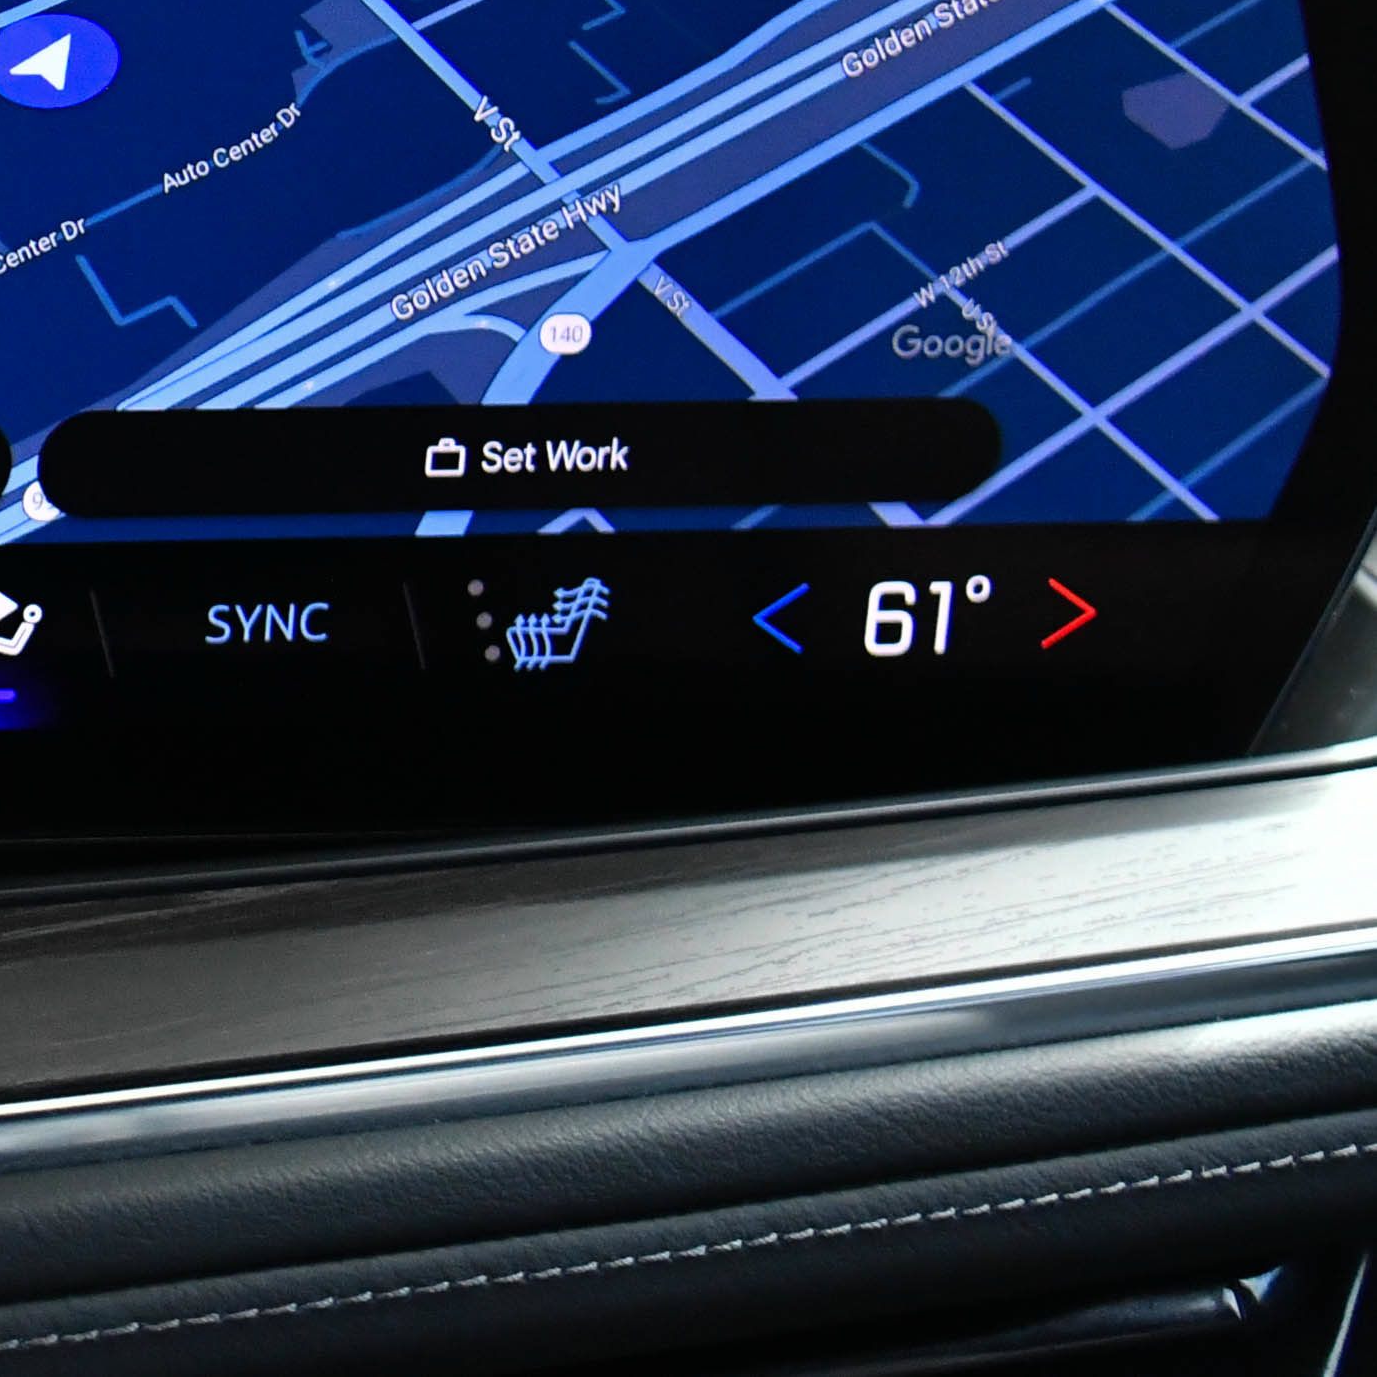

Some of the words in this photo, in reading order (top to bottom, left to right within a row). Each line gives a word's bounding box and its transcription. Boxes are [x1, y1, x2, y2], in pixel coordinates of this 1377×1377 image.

[841, 16, 934, 80] Golden
[160, 155, 211, 194] Auto
[212, 120, 282, 169] Center
[275, 101, 302, 131] Dr
[473, 95, 493, 123] V
[490, 115, 523, 153] St
[60, 216, 88, 242] Dr
[390, 258, 487, 323] Golden
[487, 220, 562, 270] State
[560, 182, 624, 233] Hwy
[651, 274, 670, 298] V
[665, 289, 692, 319] St
[912, 283, 937, 309] W
[940, 255, 986, 291] 12th
[983, 239, 1010, 266] St
[549, 324, 584, 345] 140
[892, 324, 1013, 366] Google
[480, 439, 537, 475] Set
[545, 436, 631, 474] Work
[204, 603, 331, 647] SYNC
[863, 573, 992, 657] 61°
